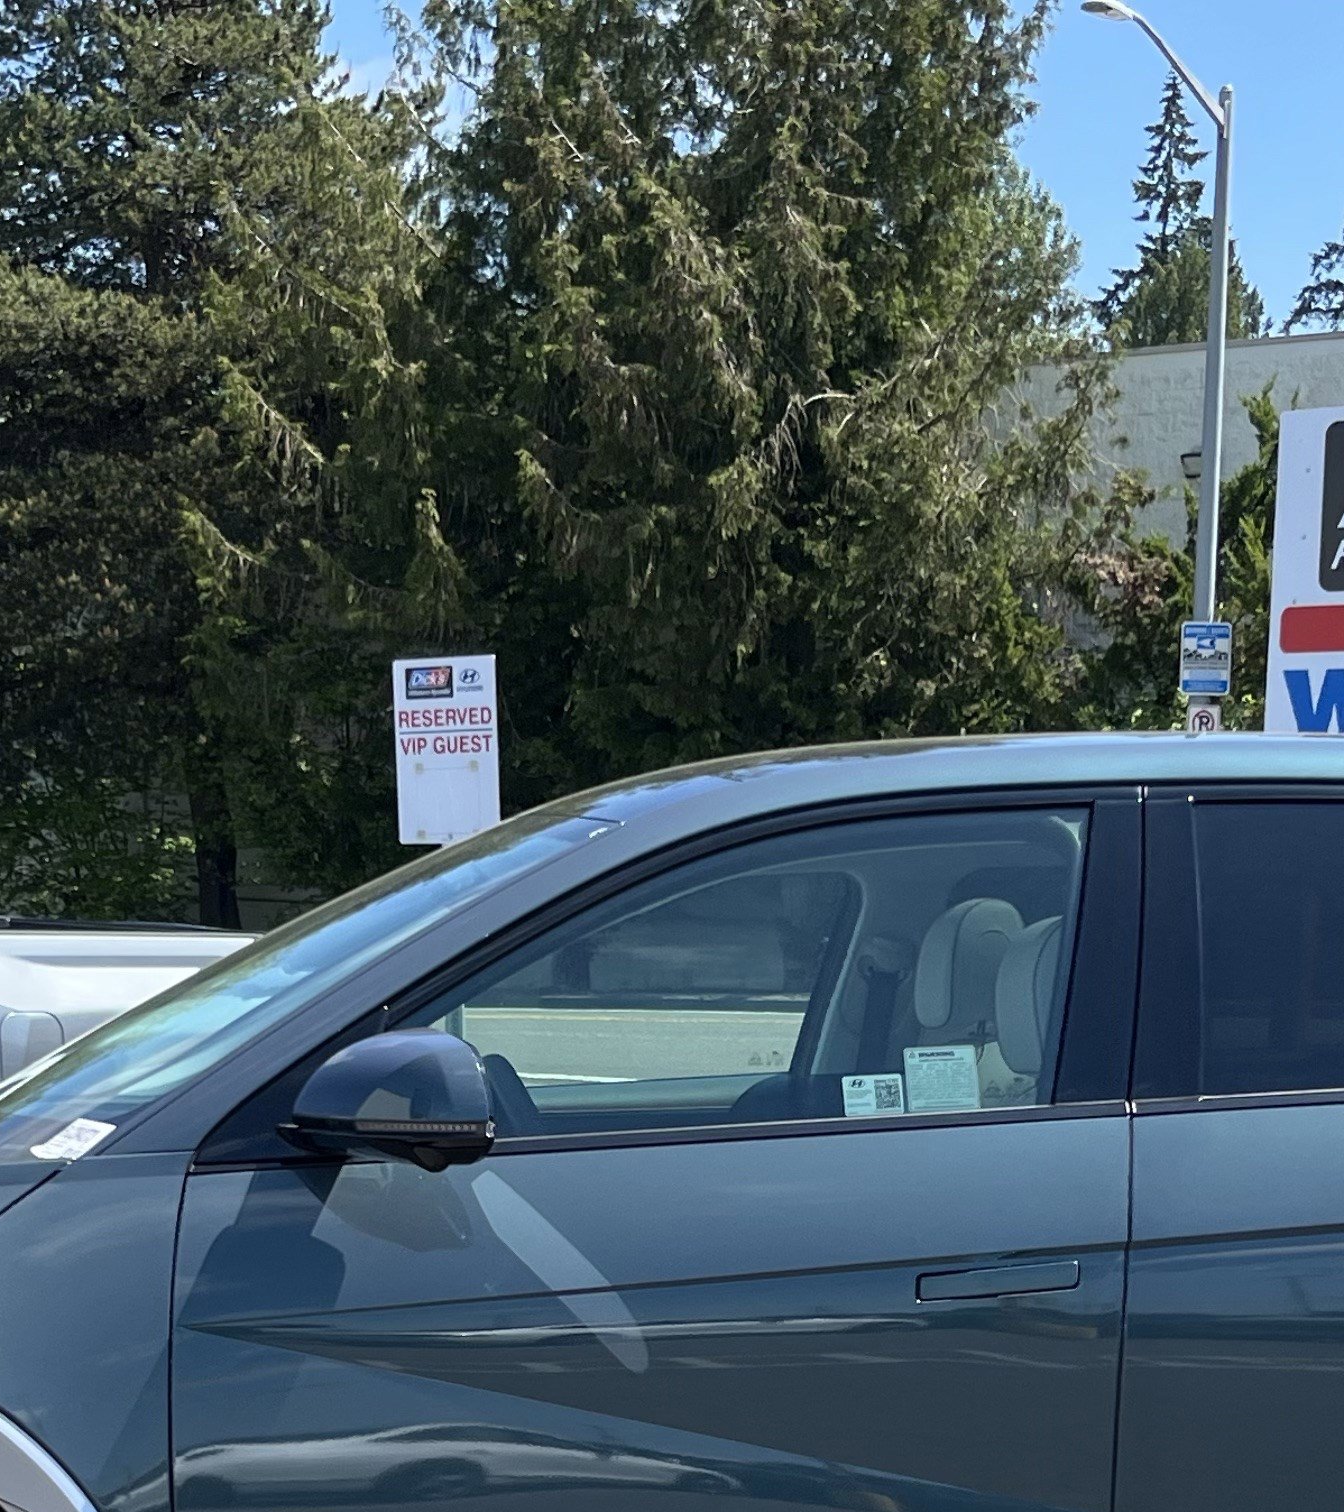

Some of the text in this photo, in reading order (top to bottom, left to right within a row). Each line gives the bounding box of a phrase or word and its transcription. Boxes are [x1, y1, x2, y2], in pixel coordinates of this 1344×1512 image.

[398, 706, 493, 729] RESERVED
[400, 734, 493, 755] VIP GUEST
